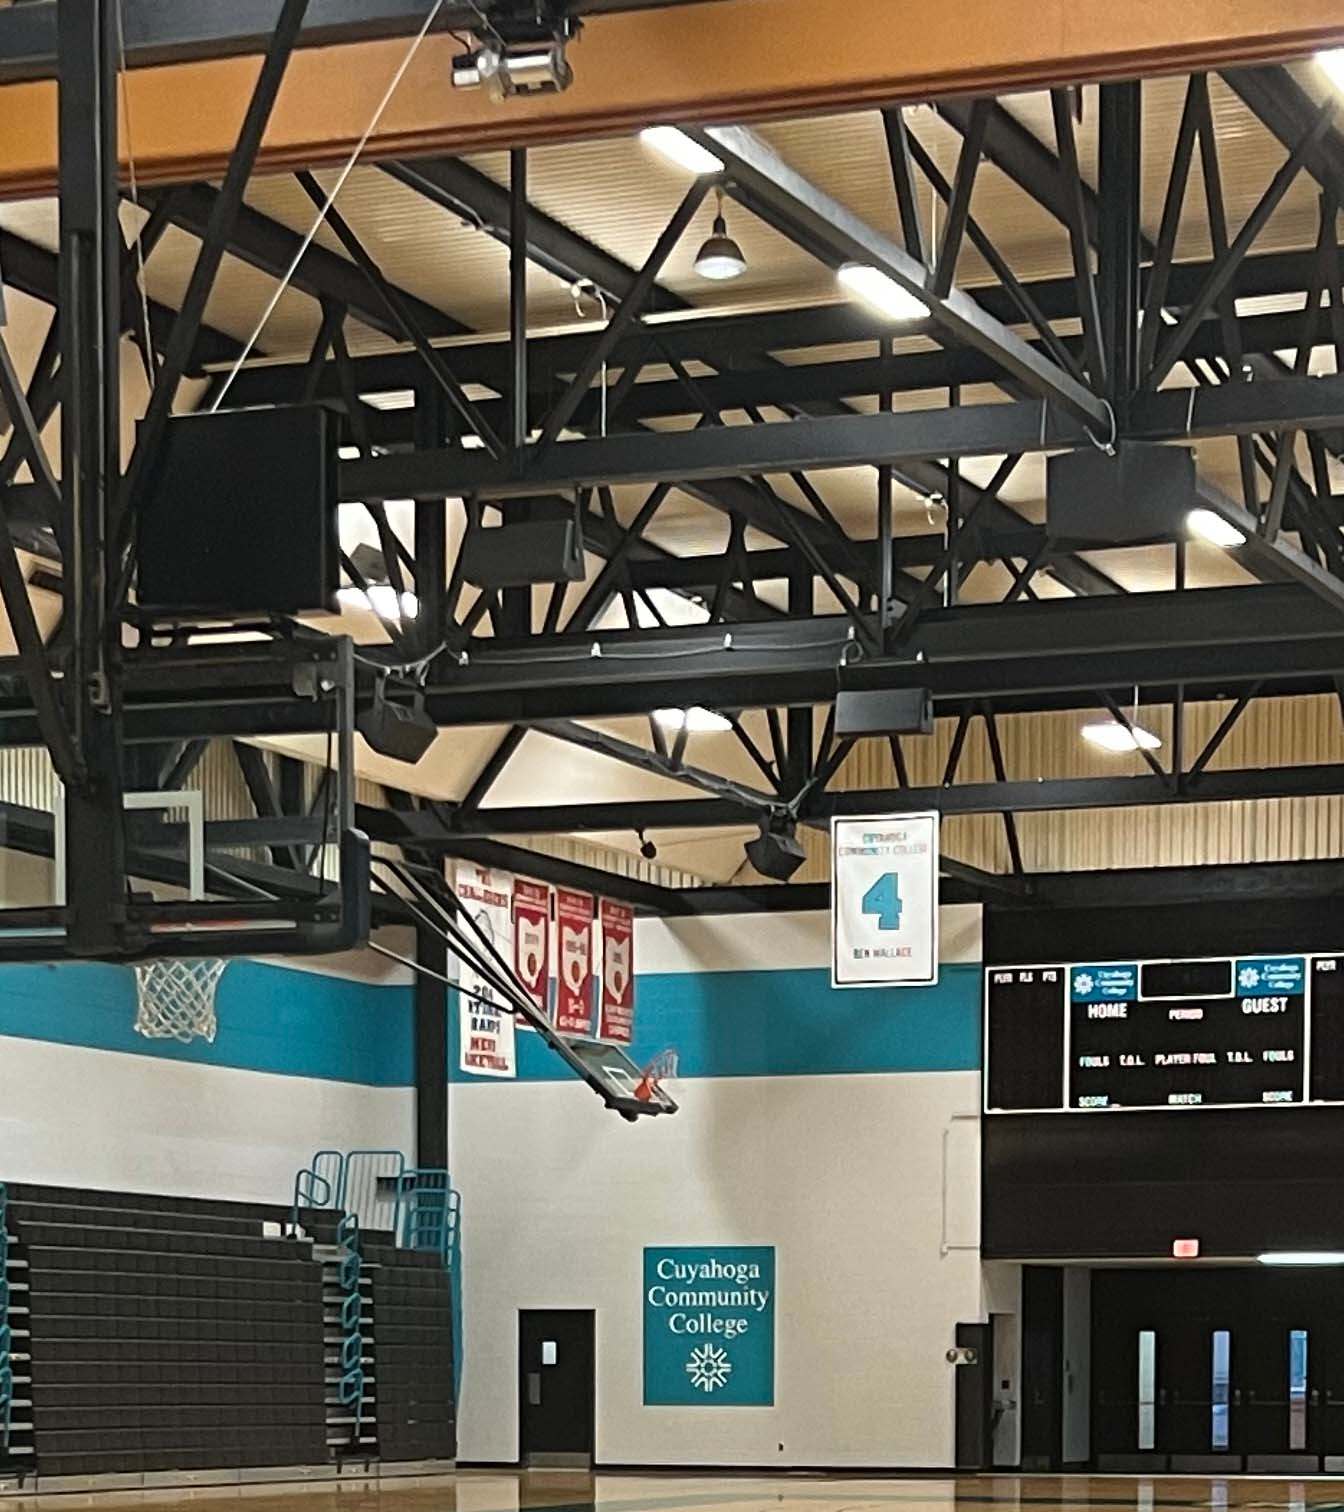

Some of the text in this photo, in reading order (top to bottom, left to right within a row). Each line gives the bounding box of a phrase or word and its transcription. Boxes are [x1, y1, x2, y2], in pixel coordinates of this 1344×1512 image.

[862, 872, 903, 930] 4
[1087, 1003, 1127, 1019] HOME
[1242, 997, 1288, 1014] GUEST
[1079, 1055, 1110, 1067] FOULS
[1155, 1053, 1192, 1066] PLAYER
[1263, 1049, 1295, 1063] FOULS
[657, 1258, 760, 1284] Cuyahoga
[648, 1286, 769, 1312] Community
[669, 1313, 748, 1339] College
